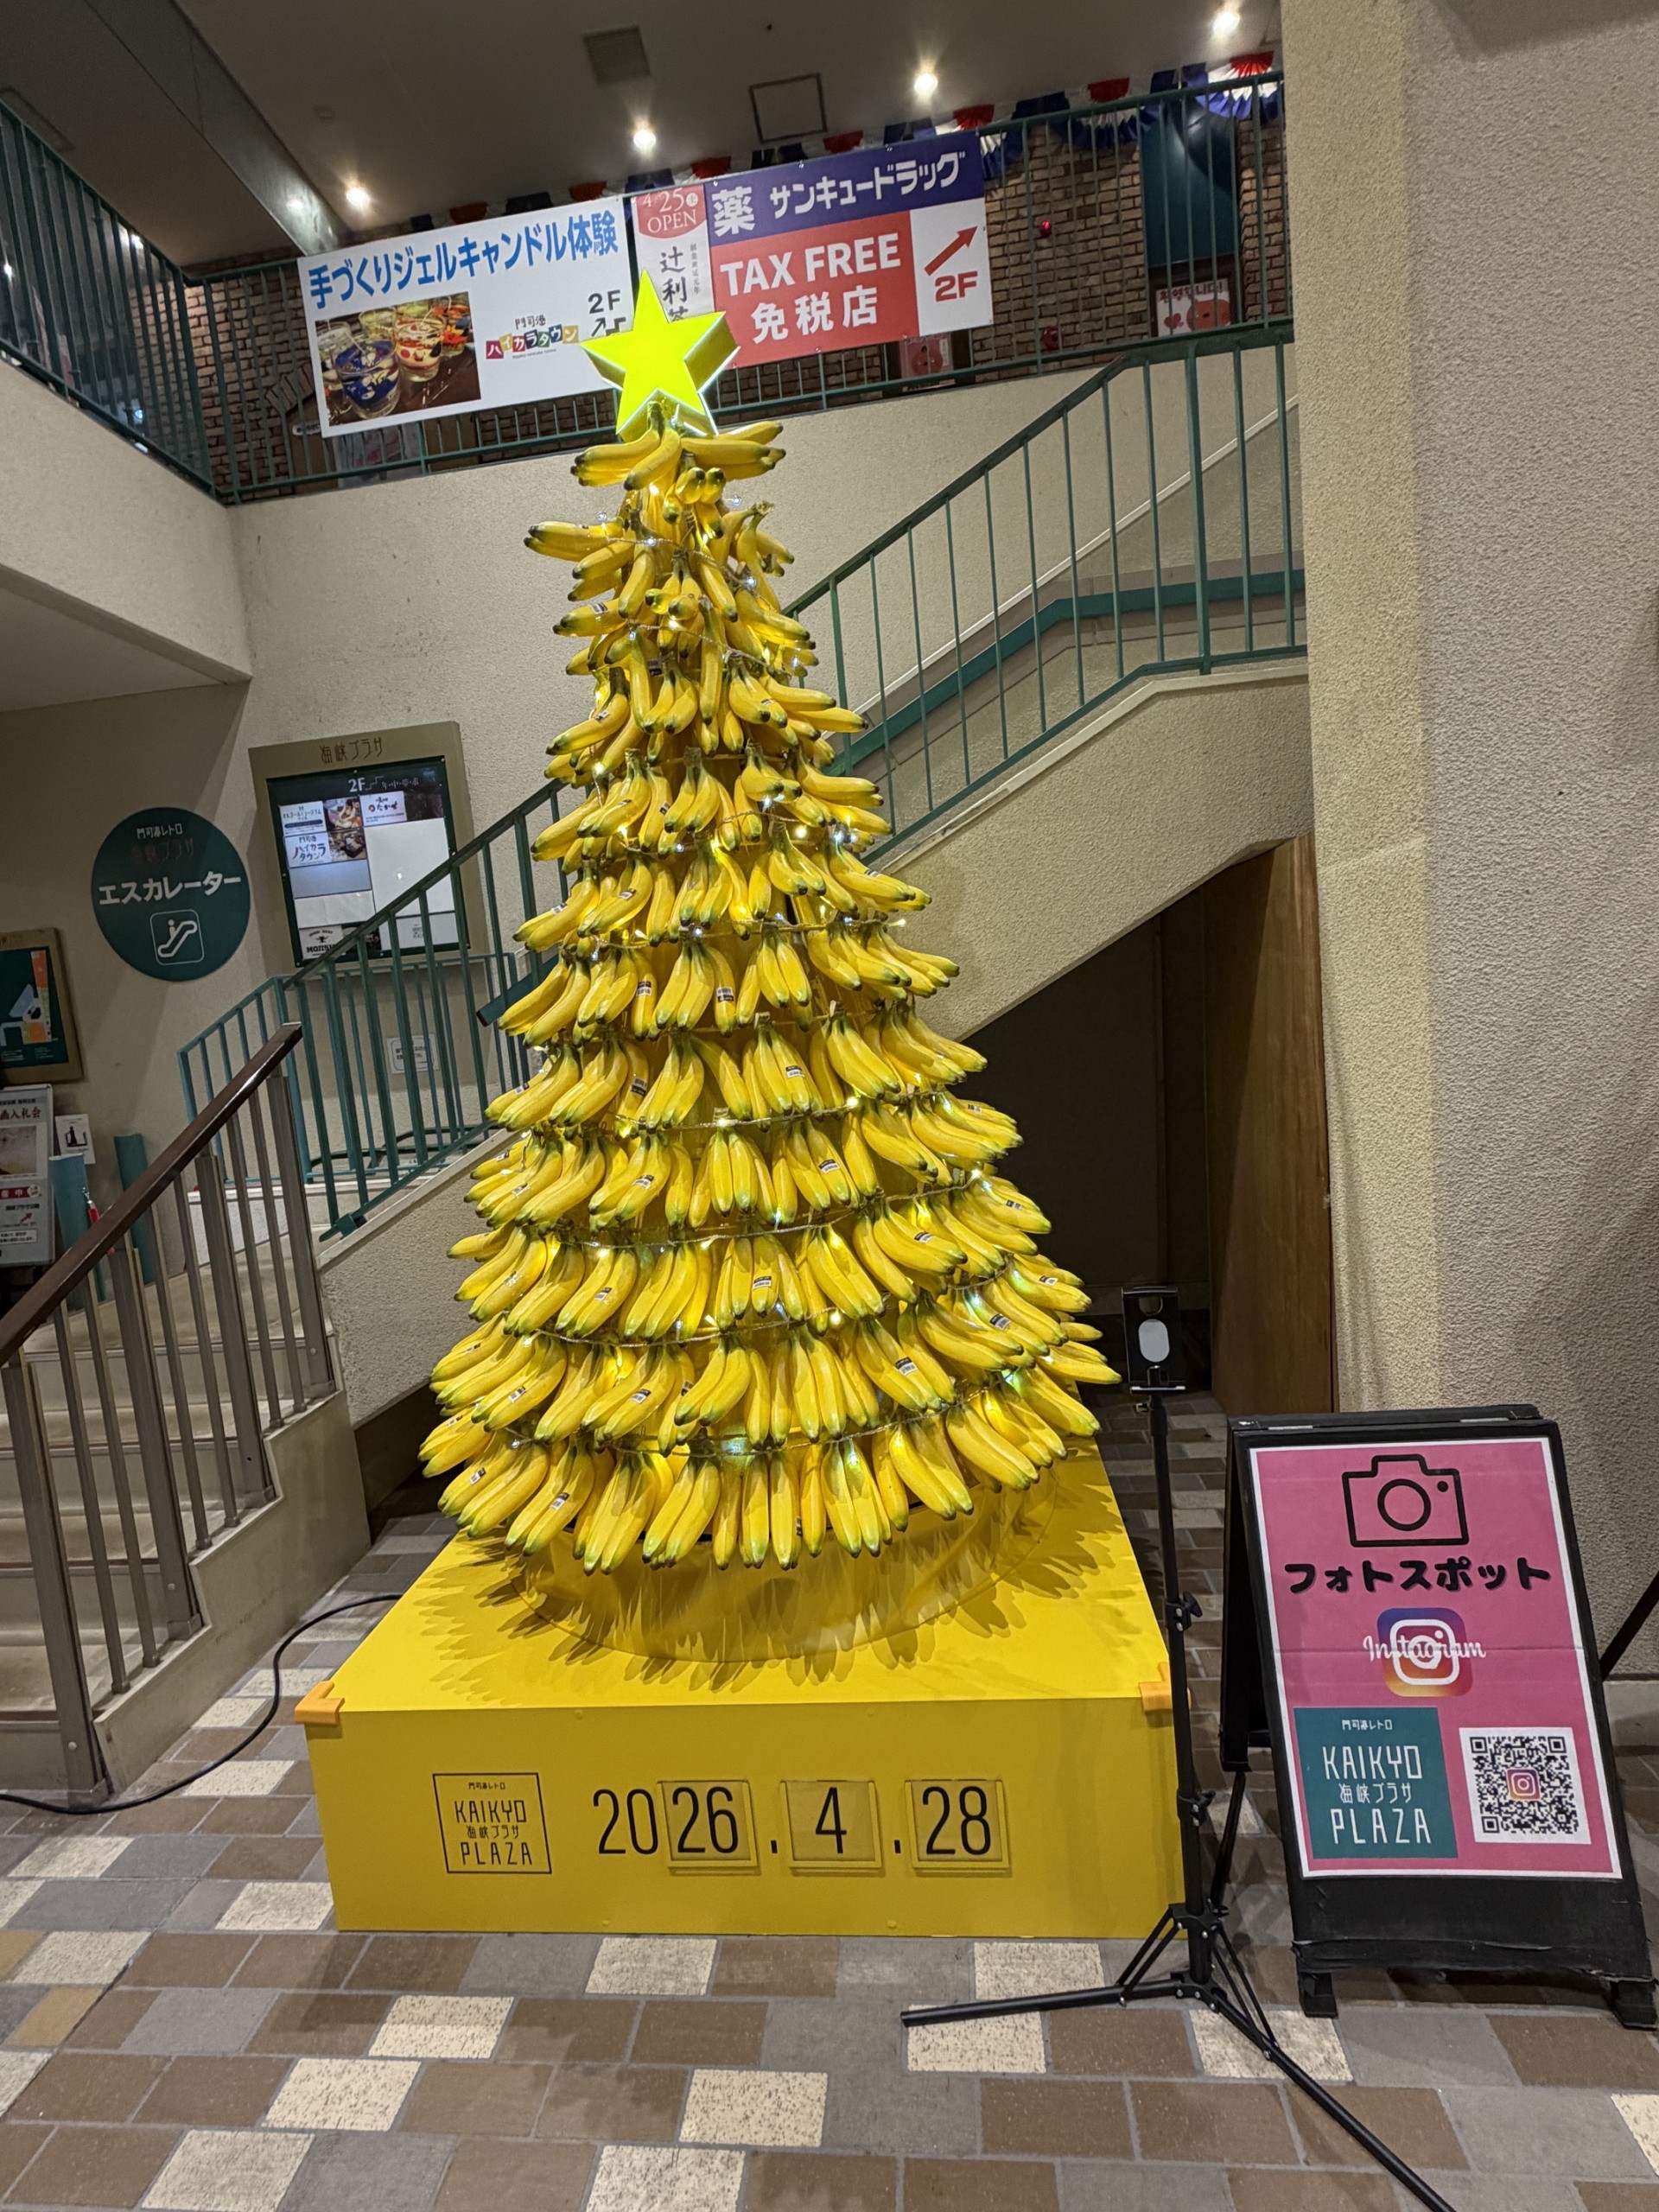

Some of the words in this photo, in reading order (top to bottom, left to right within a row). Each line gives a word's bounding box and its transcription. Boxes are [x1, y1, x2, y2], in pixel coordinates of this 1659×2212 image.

[770, 151, 966, 219] サンキュードラッグ
[647, 209, 697, 234] OPEN
[711, 187, 755, 237] 薬
[308, 209, 619, 309] 手づくりジェルキャンドル体験
[721, 251, 795, 296] TAX
[804, 232, 902, 283] FREE
[588, 289, 623, 315] 2F
[934, 270, 979, 303] 2F
[515, 315, 547, 330] 門司港
[750, 284, 878, 345] 免税店
[486, 325, 578, 359] ハイカラタウン
[348, 777, 366, 793] 2F
[137, 823, 183, 840] 門司港レトロ
[99, 871, 242, 906] エスカレーター
[1284, 1556, 1552, 1593] フォトスポット
[1363, 1635, 1486, 1669] Instagram
[1342, 1719, 1393, 1732] 門司港レトロ
[1322, 1745, 1423, 1781] KAIKYO
[454, 1800, 527, 1823] KAIKYO
[1330, 1808, 1432, 1845] PLAZA
[461, 1841, 533, 1866] PLAZA
